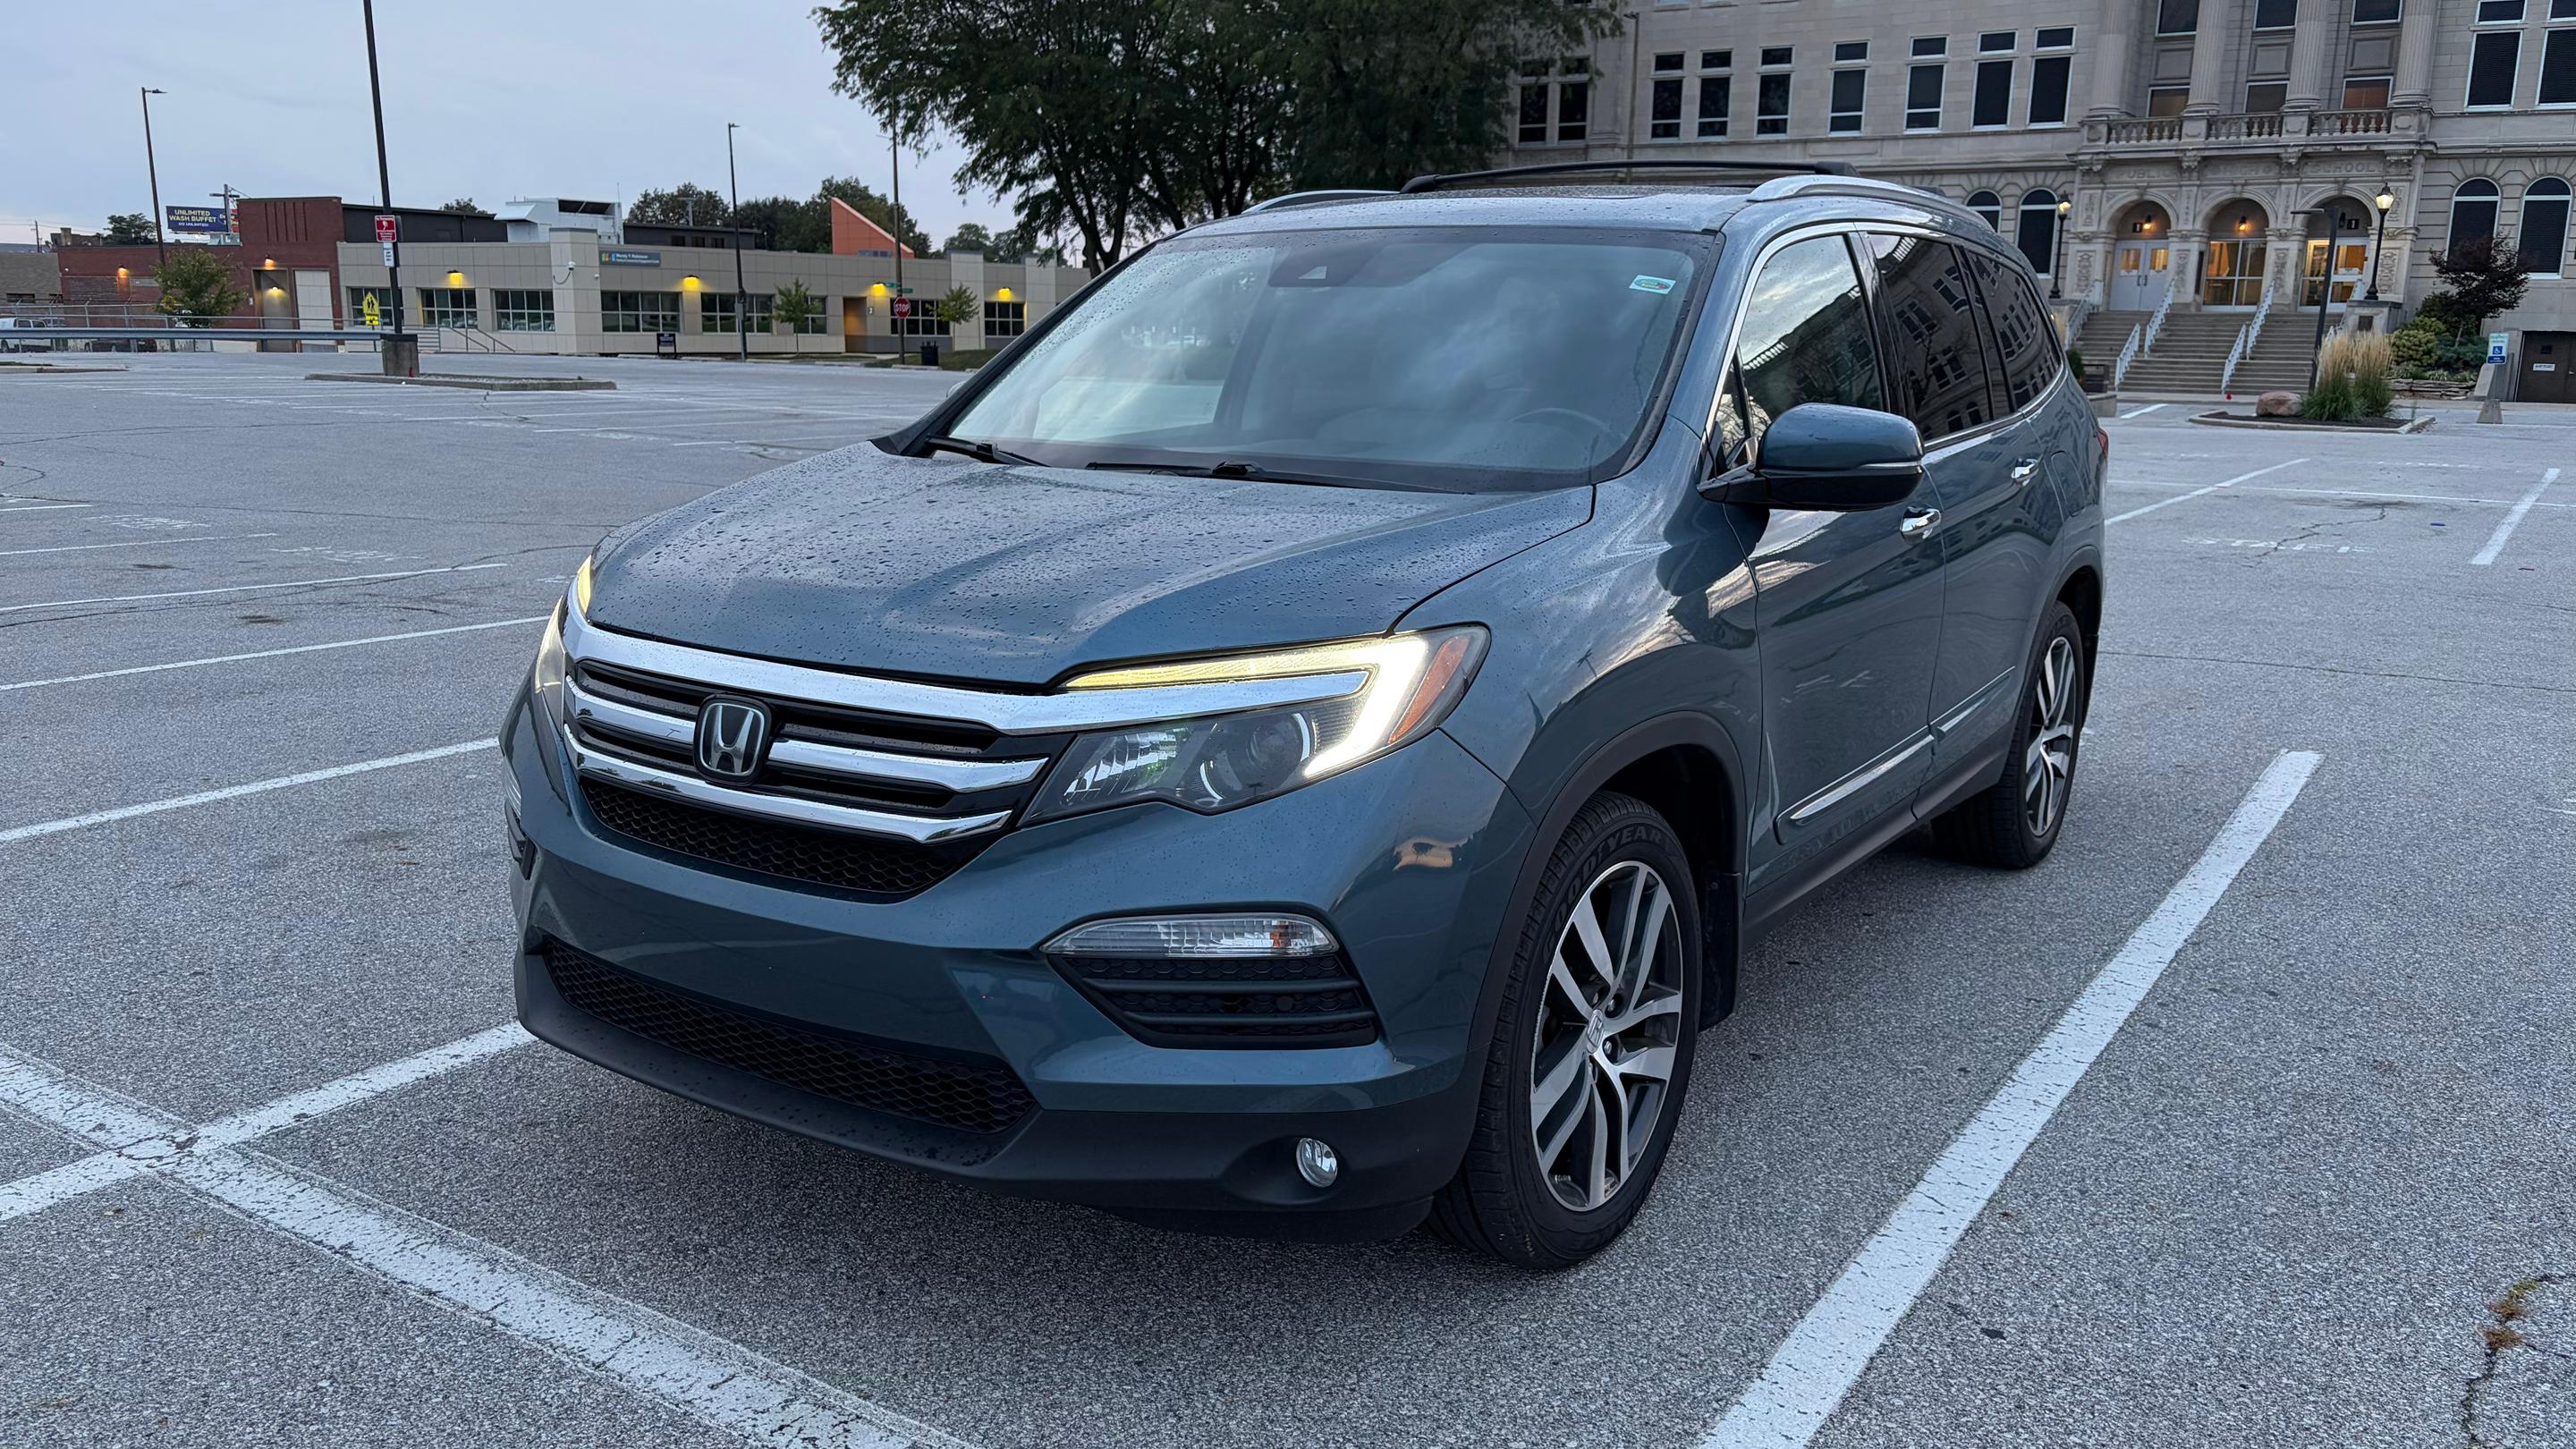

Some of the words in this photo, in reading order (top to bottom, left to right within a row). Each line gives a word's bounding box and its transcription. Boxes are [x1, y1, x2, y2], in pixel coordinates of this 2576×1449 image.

[2310, 163, 2377, 174] SCHOOL
[895, 303, 910, 312] STOP
[1542, 826, 1664, 965] GOODYEAR
